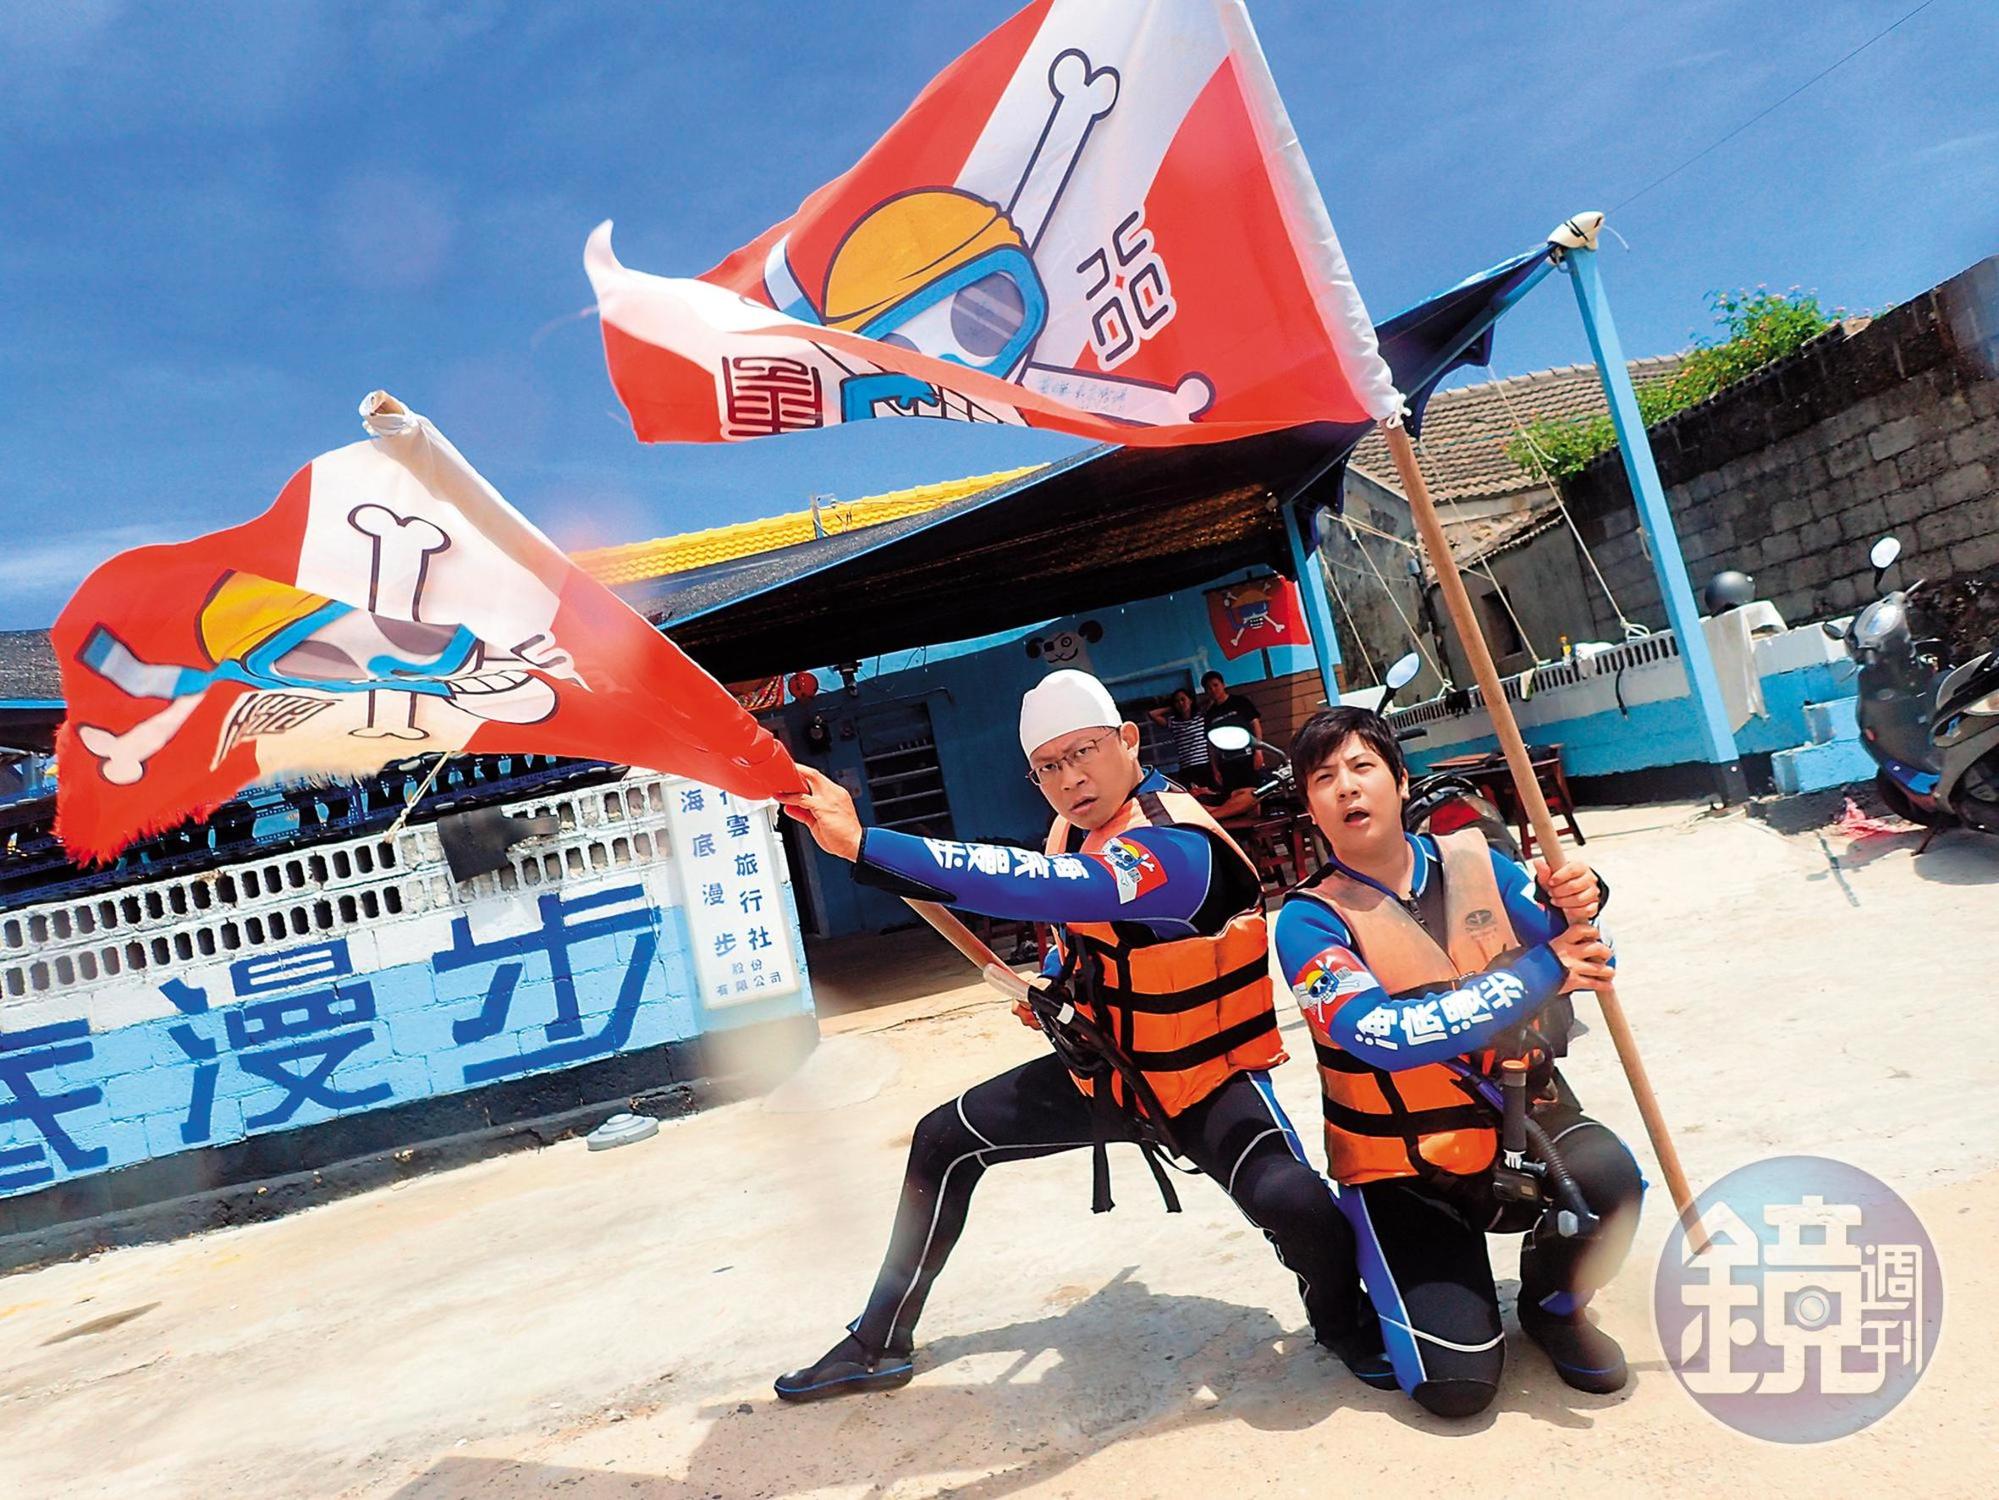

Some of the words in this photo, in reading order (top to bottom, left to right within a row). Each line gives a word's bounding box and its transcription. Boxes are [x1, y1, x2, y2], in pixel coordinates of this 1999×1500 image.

[680, 788, 737, 958] 海底漫步
[718, 790, 773, 951] 雲旅行社
[716, 971, 782, 997] 有限公司
[732, 959, 763, 975] 股份
[1354, 971, 1527, 1051] 海底漫步
